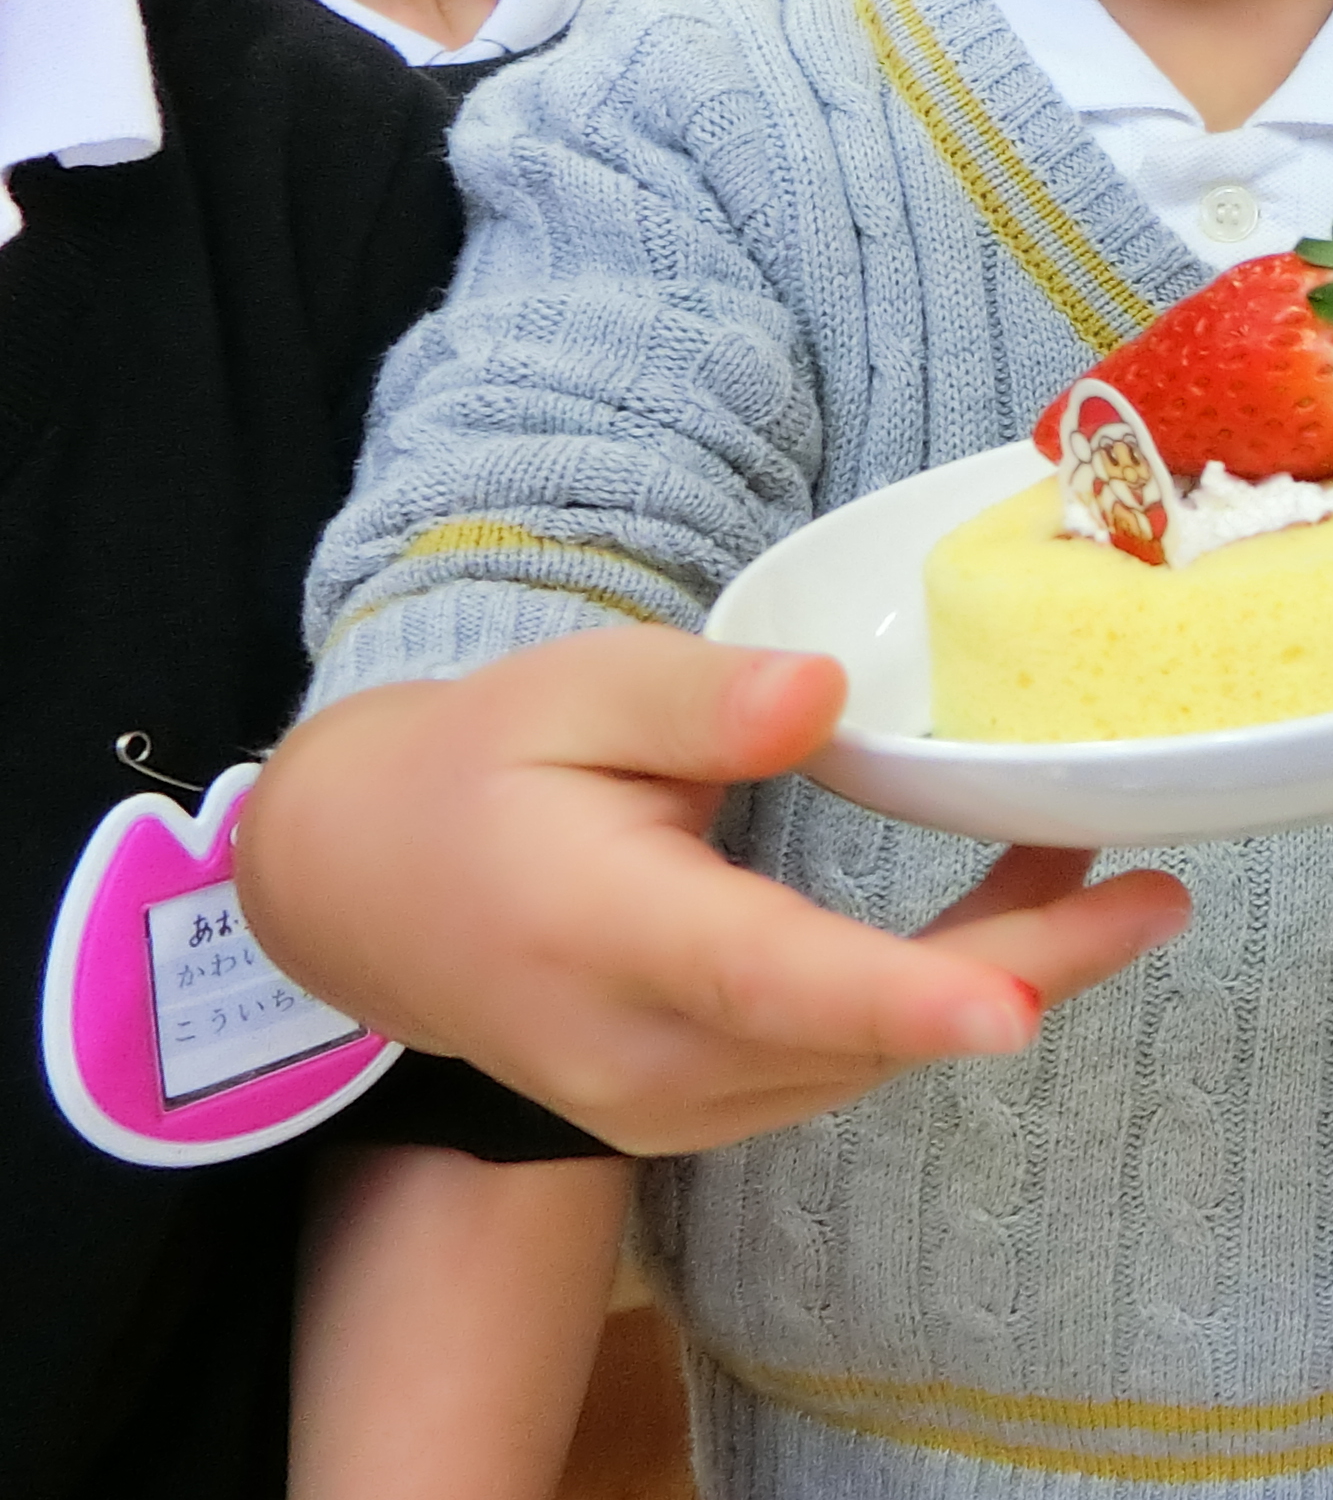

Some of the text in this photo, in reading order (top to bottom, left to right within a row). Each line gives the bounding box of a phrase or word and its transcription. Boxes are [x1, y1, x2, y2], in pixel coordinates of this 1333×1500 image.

[188, 909, 248, 948] あお
[175, 989, 308, 1042] こういち
